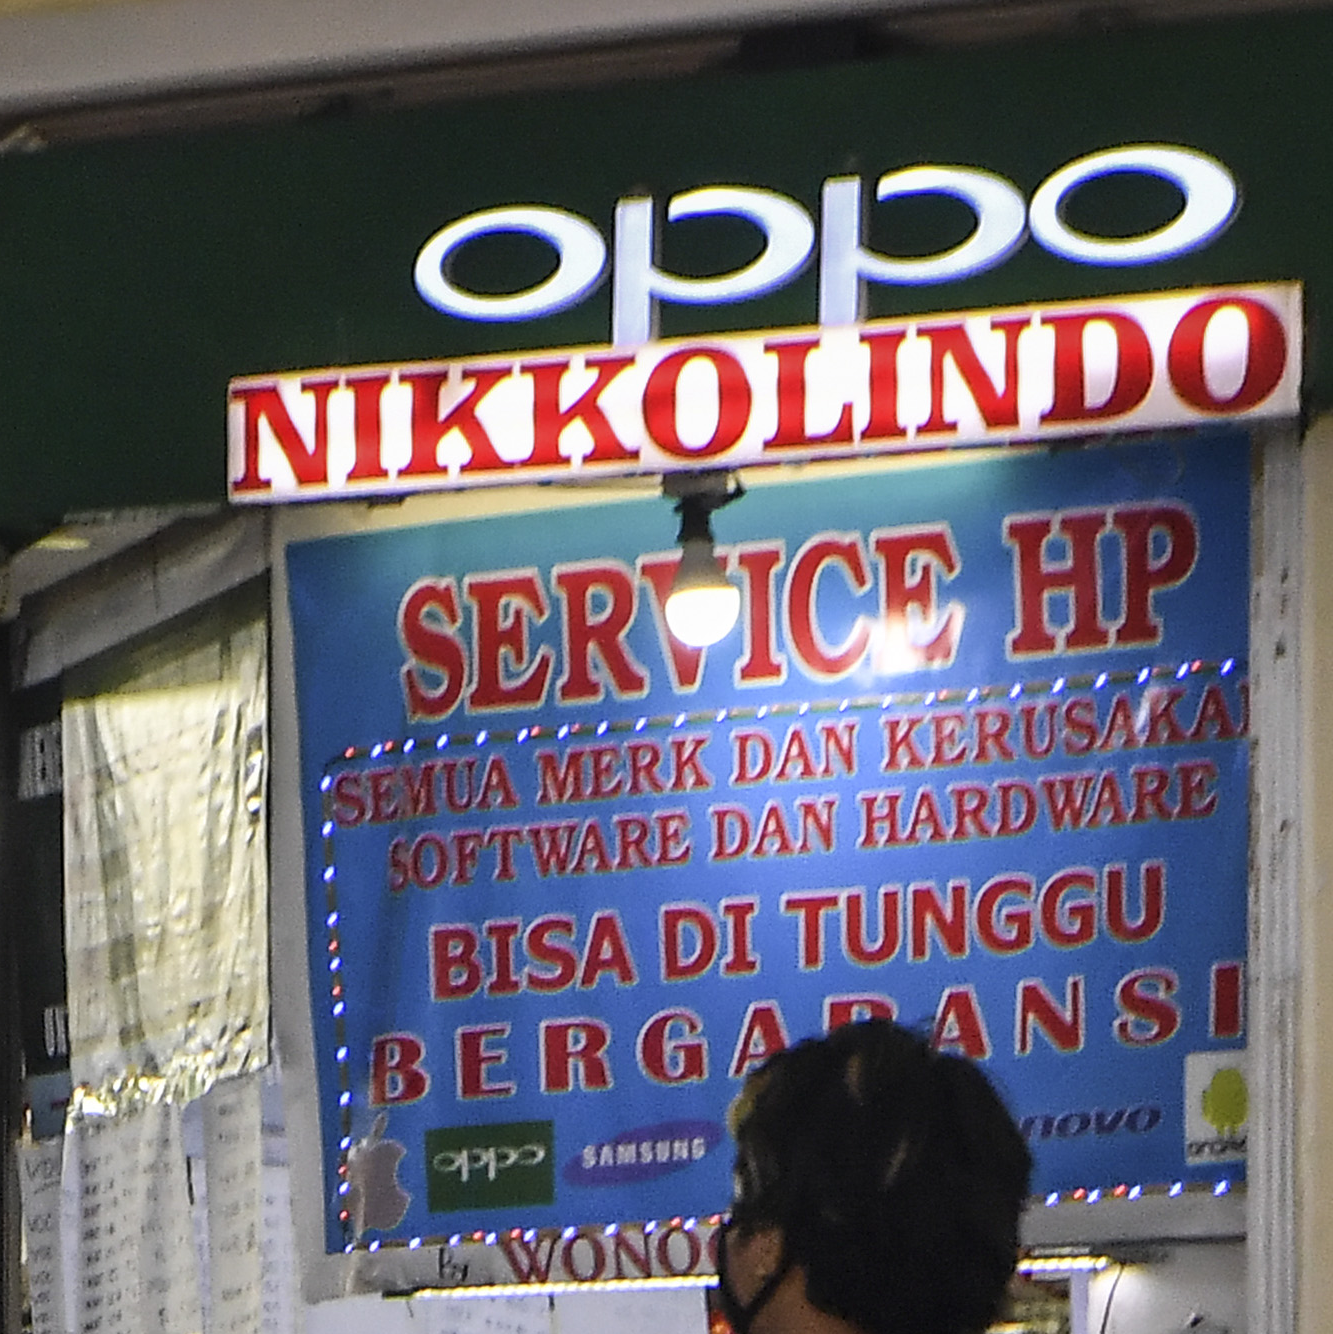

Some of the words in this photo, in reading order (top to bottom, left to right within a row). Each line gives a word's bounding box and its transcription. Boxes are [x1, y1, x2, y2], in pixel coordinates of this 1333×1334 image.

[414, 143, 1238, 343] oppo
[230, 295, 1287, 493] NIKKOLINDO
[1006, 504, 1199, 660] HP
[333, 755, 519, 828] SEMUA
[536, 735, 713, 804] MERK
[732, 719, 856, 785] DAN
[388, 809, 691, 894] SOFTWARE
[711, 796, 835, 861] DAN
[858, 761, 1218, 849] HARDWARE
[429, 911, 636, 1000] BISA
[660, 896, 760, 983] DI
[783, 860, 1165, 970] TUNGGU
[433, 1145, 545, 1182] oppo
[581, 1138, 706, 1168] SAMSUNG
[1019, 1106, 1162, 1140] novo
[501, 1228, 719, 1283] WONO
